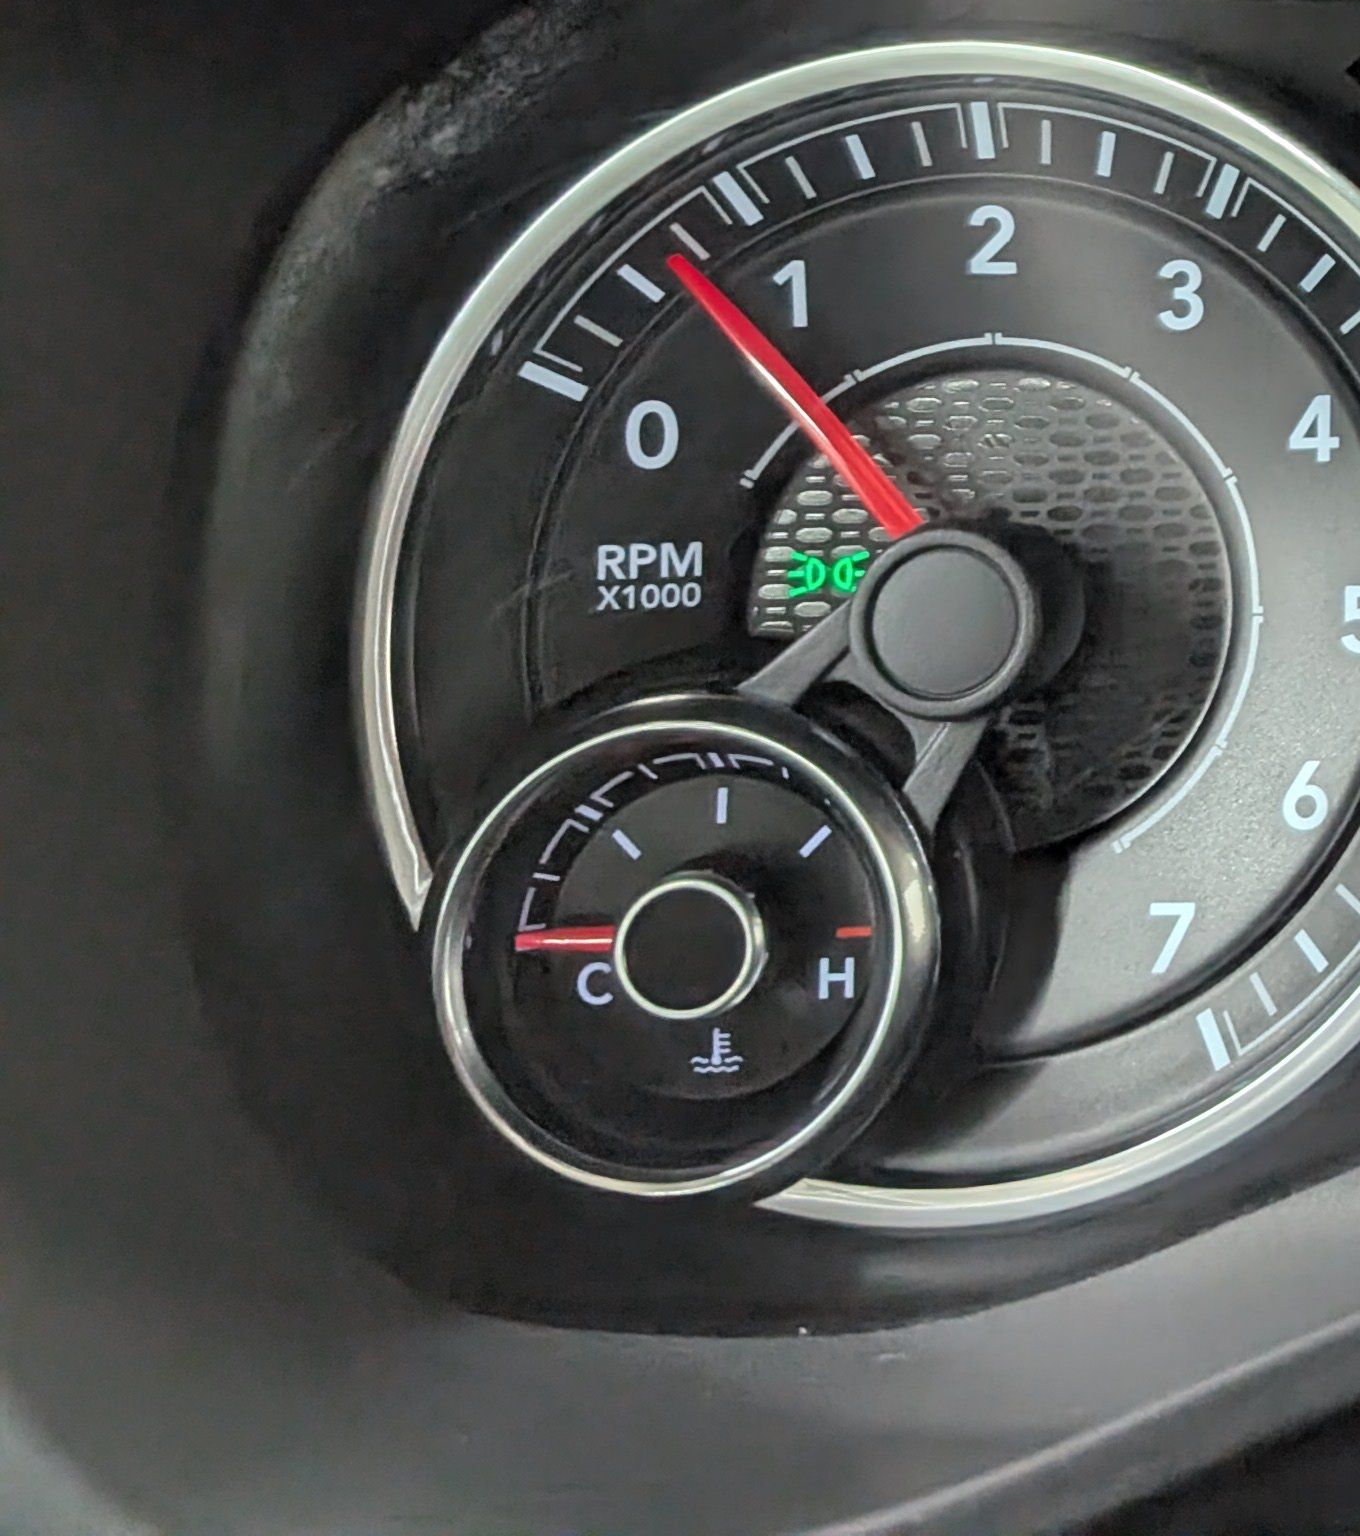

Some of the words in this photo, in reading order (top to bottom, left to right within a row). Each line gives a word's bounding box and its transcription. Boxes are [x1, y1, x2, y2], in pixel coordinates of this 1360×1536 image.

[968, 204, 1018, 275] 2
[772, 259, 808, 328] 1
[1157, 259, 1204, 331] 3
[624, 399, 679, 470] 0
[1287, 394, 1340, 463] 4
[596, 541, 703, 581] RPM
[596, 577, 702, 611] X1000
[1282, 759, 1329, 831] 6
[1149, 902, 1196, 975] 7
[576, 961, 614, 1006] C
[818, 956, 855, 1000] H
